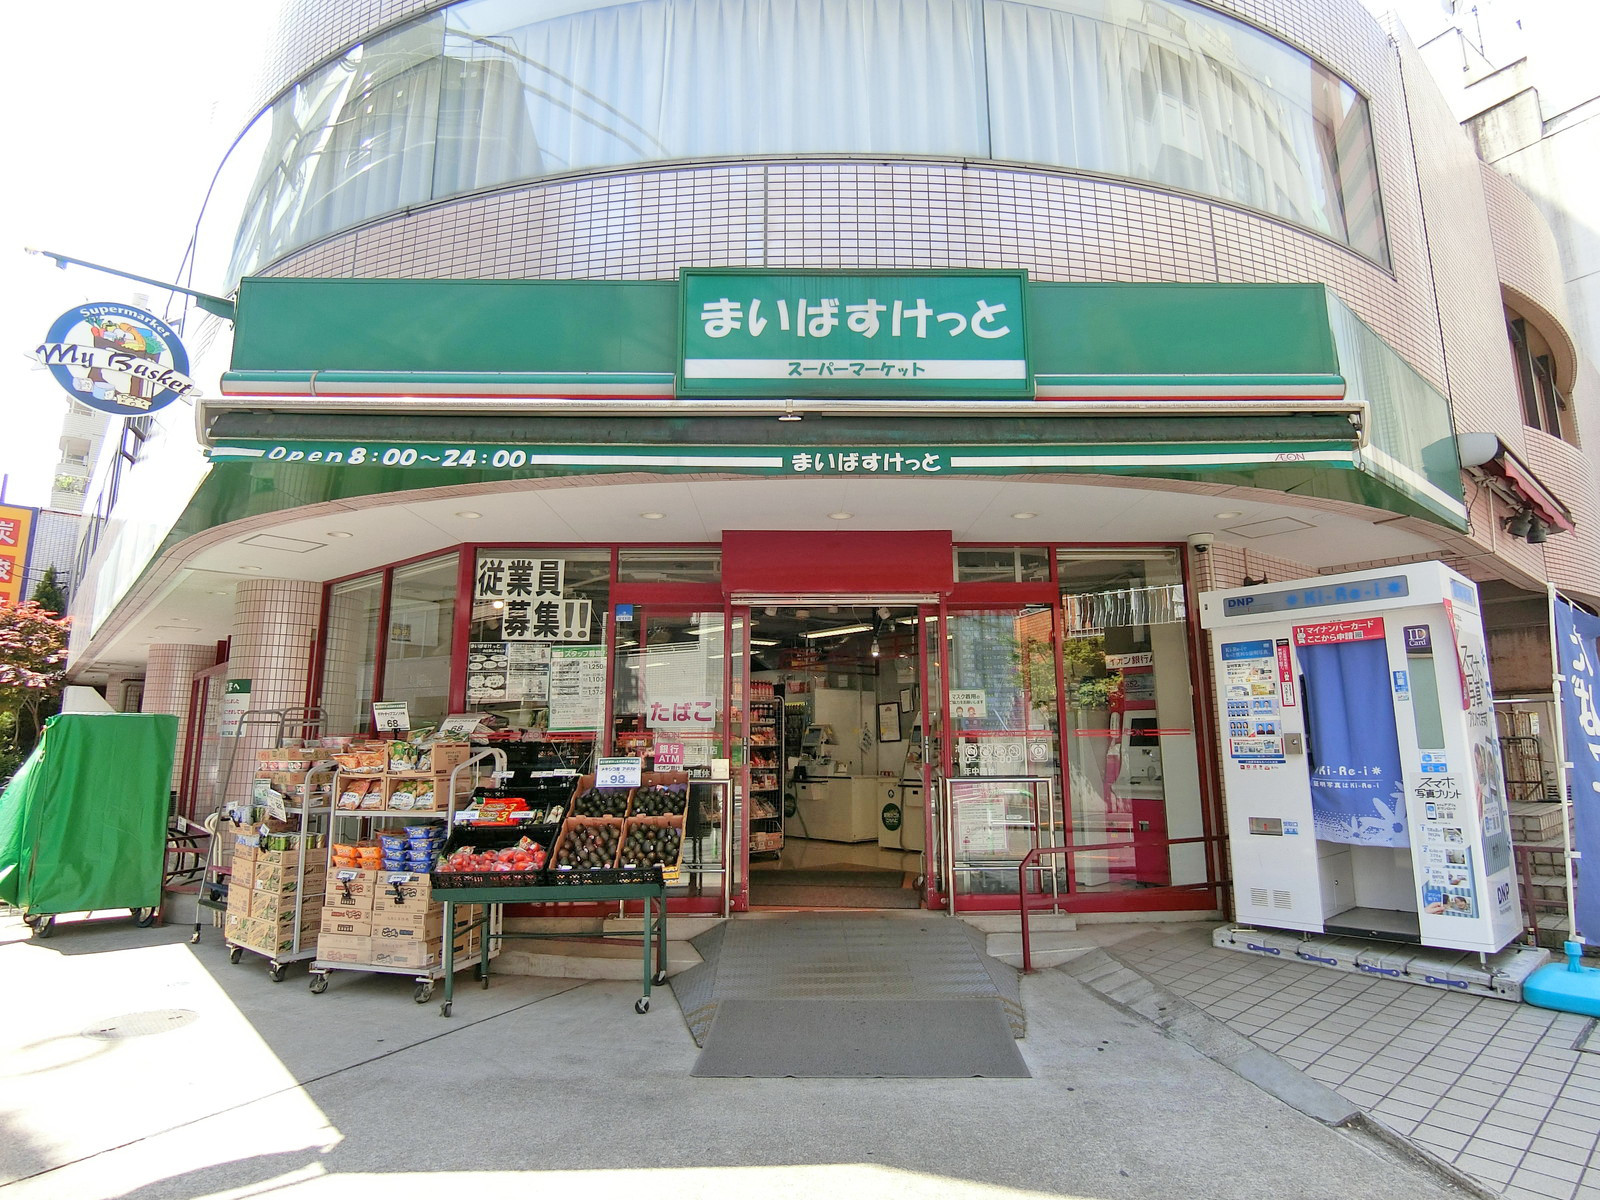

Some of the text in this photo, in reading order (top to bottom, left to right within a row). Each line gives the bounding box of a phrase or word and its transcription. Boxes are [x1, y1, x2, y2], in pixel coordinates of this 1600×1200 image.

[80, 304, 171, 339] Supermarket
[700, 297, 1011, 339] まいばすけっと
[35, 344, 194, 395] My Basket
[788, 361, 926, 377] スーパーマーケット
[268, 446, 343, 464] Open
[791, 452, 942, 472] まいばすけっと
[477, 559, 562, 597] 従業員
[1228, 597, 1254, 608] DNP
[1306, 620, 1374, 634] マイナンバーカード
[1407, 628, 1426, 641] ID
[1408, 638, 1426, 647] Card
[650, 701, 713, 722] たばこ
[387, 719, 399, 728] 68
[450, 724, 464, 732] 68
[659, 744, 680, 754] 銀行
[658, 754, 680, 763] ATM
[610, 774, 626, 784] 98
[1418, 776, 1456, 789] スマホ
[1414, 788, 1462, 800] 写真プリント
[1496, 882, 1510, 905] DNP
